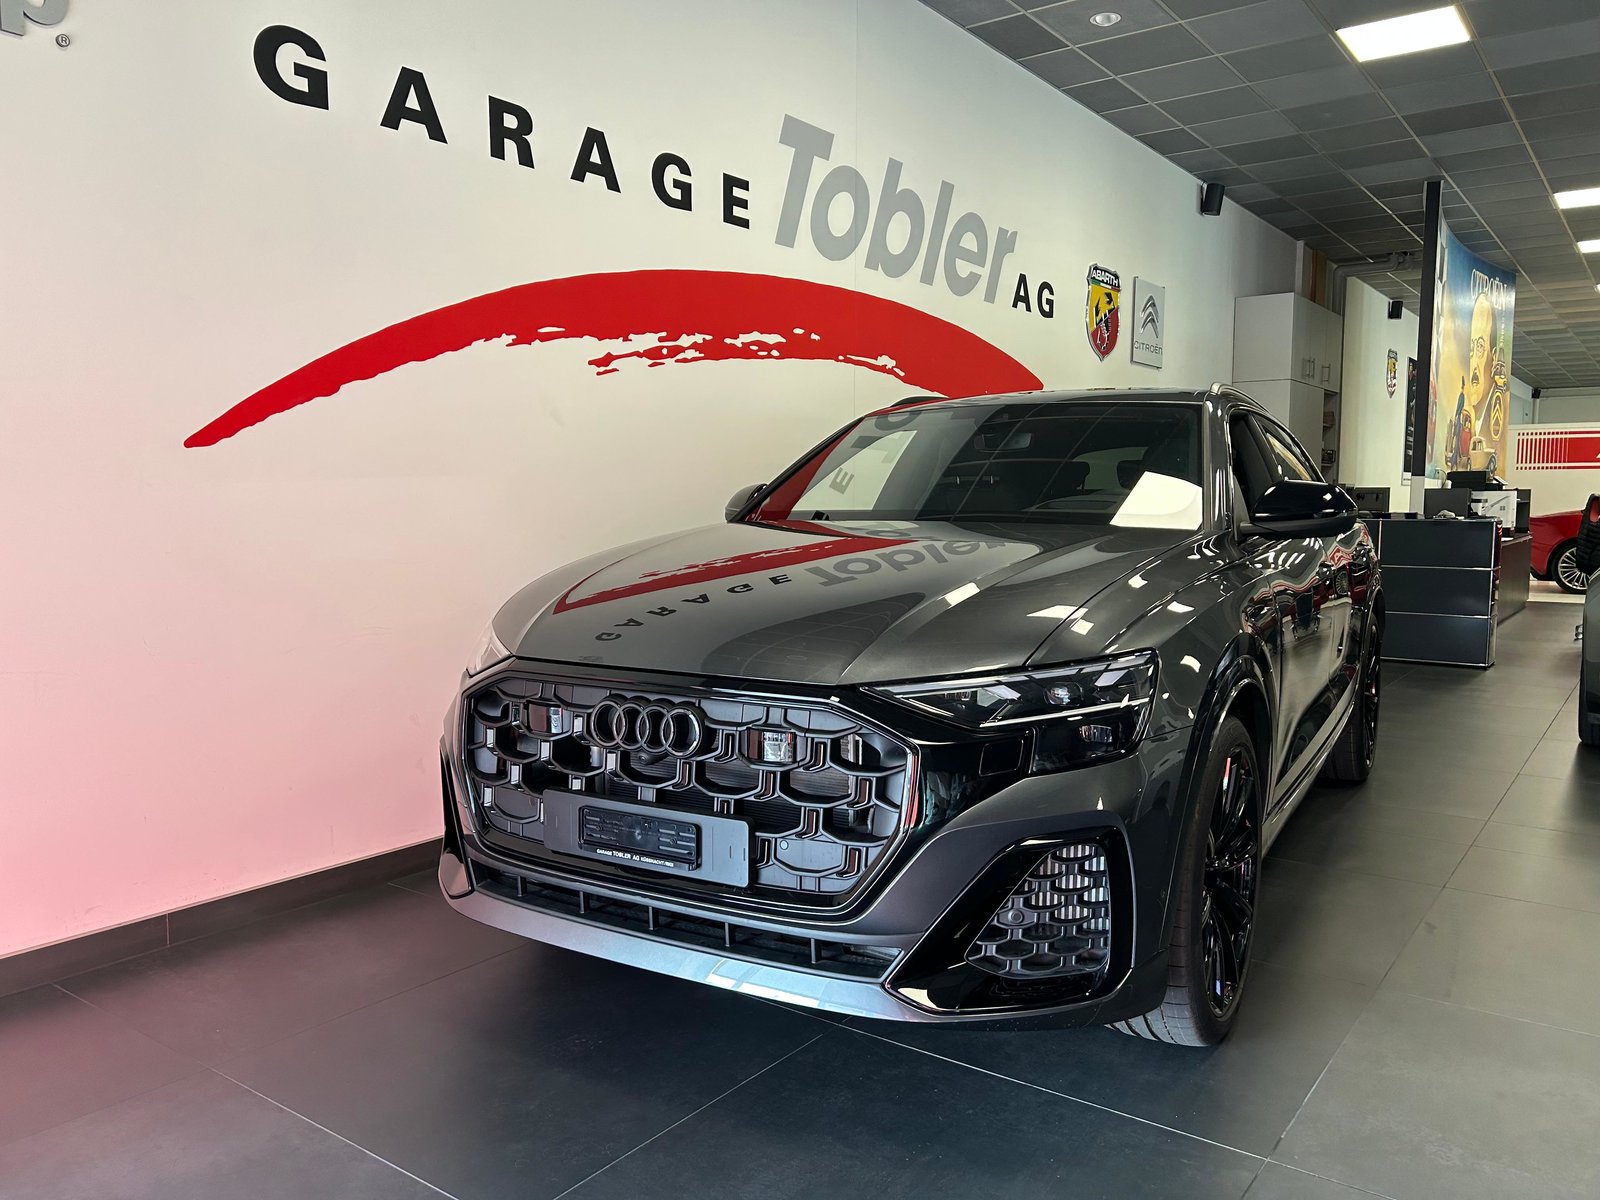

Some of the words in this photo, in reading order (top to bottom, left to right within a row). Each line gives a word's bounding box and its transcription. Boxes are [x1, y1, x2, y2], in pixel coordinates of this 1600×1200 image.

[253, 24, 750, 230] GARAGE
[774, 113, 1019, 305] Tobler
[1011, 272, 1055, 319] AG
[1091, 269, 1119, 287] ABARTH
[613, 851, 632, 860] TOBLER
